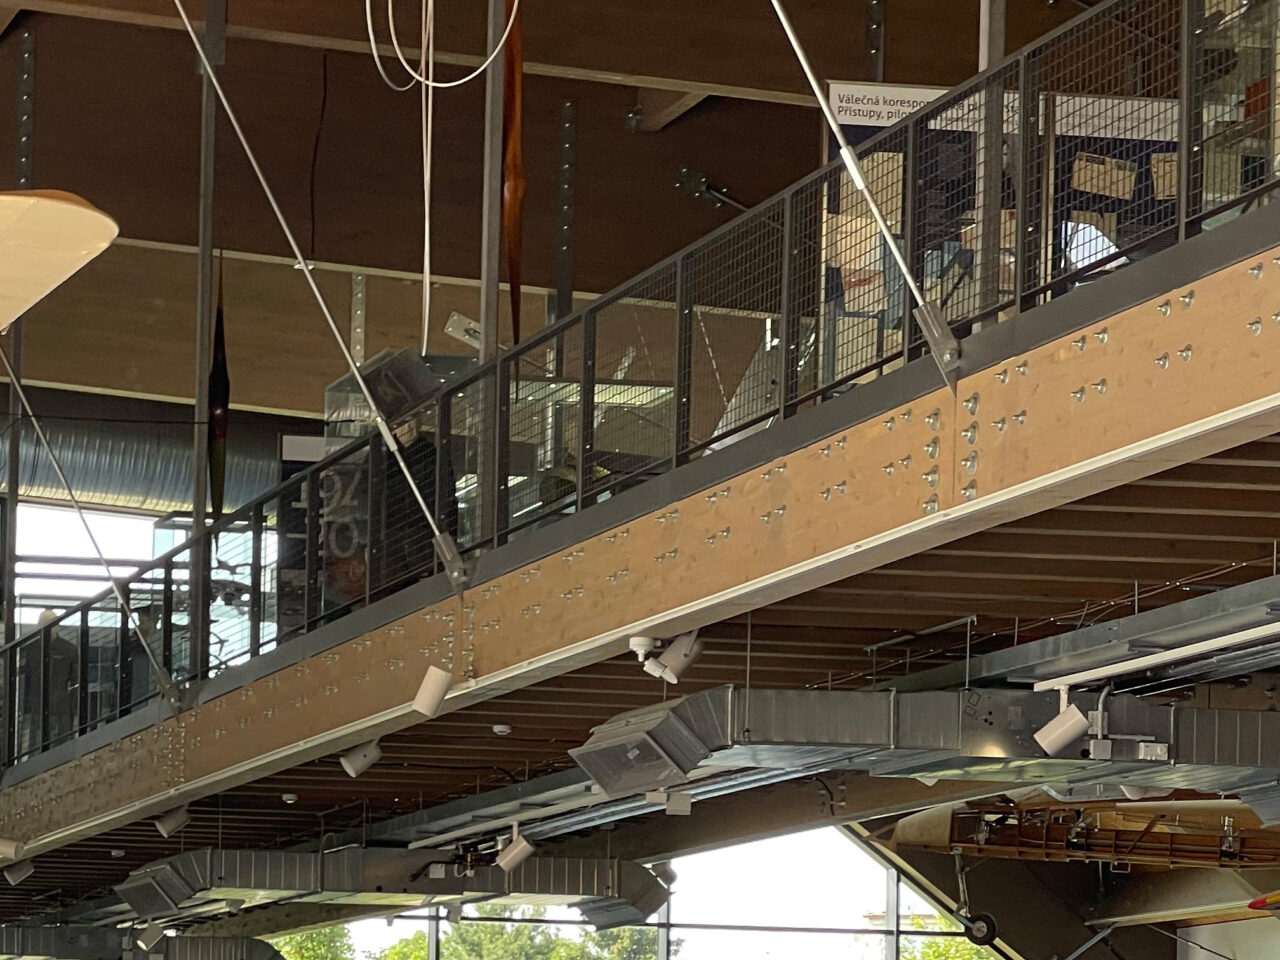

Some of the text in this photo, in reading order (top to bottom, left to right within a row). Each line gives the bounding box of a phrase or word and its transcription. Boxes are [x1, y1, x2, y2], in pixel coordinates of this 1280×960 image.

[838, 93, 931, 109] Válečná korespo
[887, 108, 911, 121] pilo
